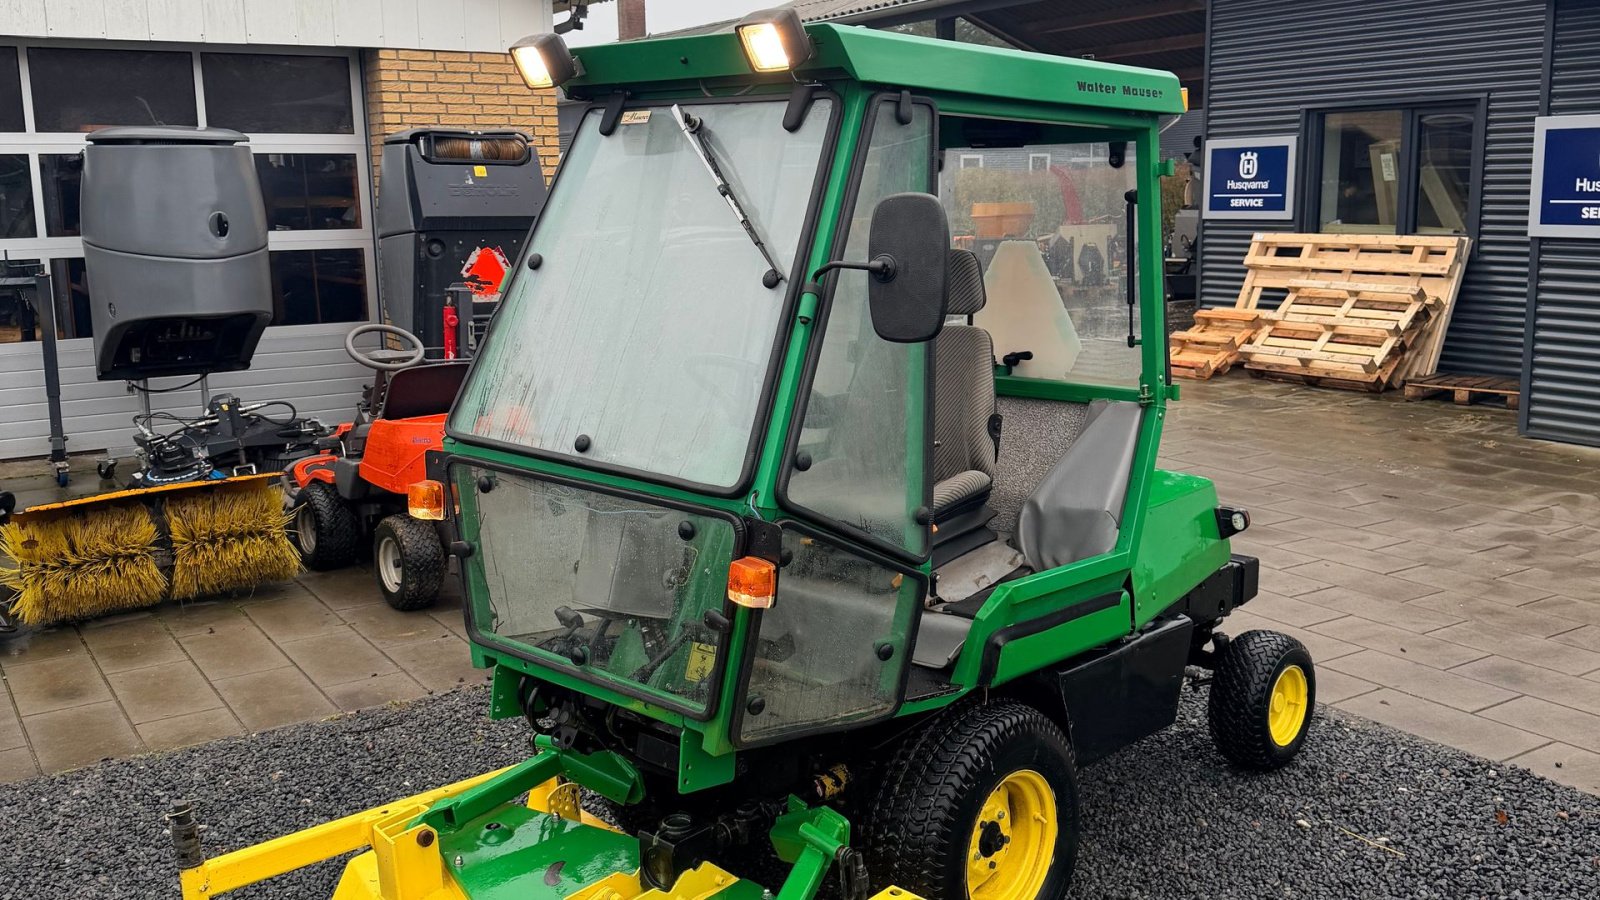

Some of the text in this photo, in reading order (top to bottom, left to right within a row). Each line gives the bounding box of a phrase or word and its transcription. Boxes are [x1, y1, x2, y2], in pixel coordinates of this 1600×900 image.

[1077, 81, 1116, 94] Walter
[1227, 180, 1269, 191] Husqvarna
[1230, 198, 1263, 207] SERVICE
